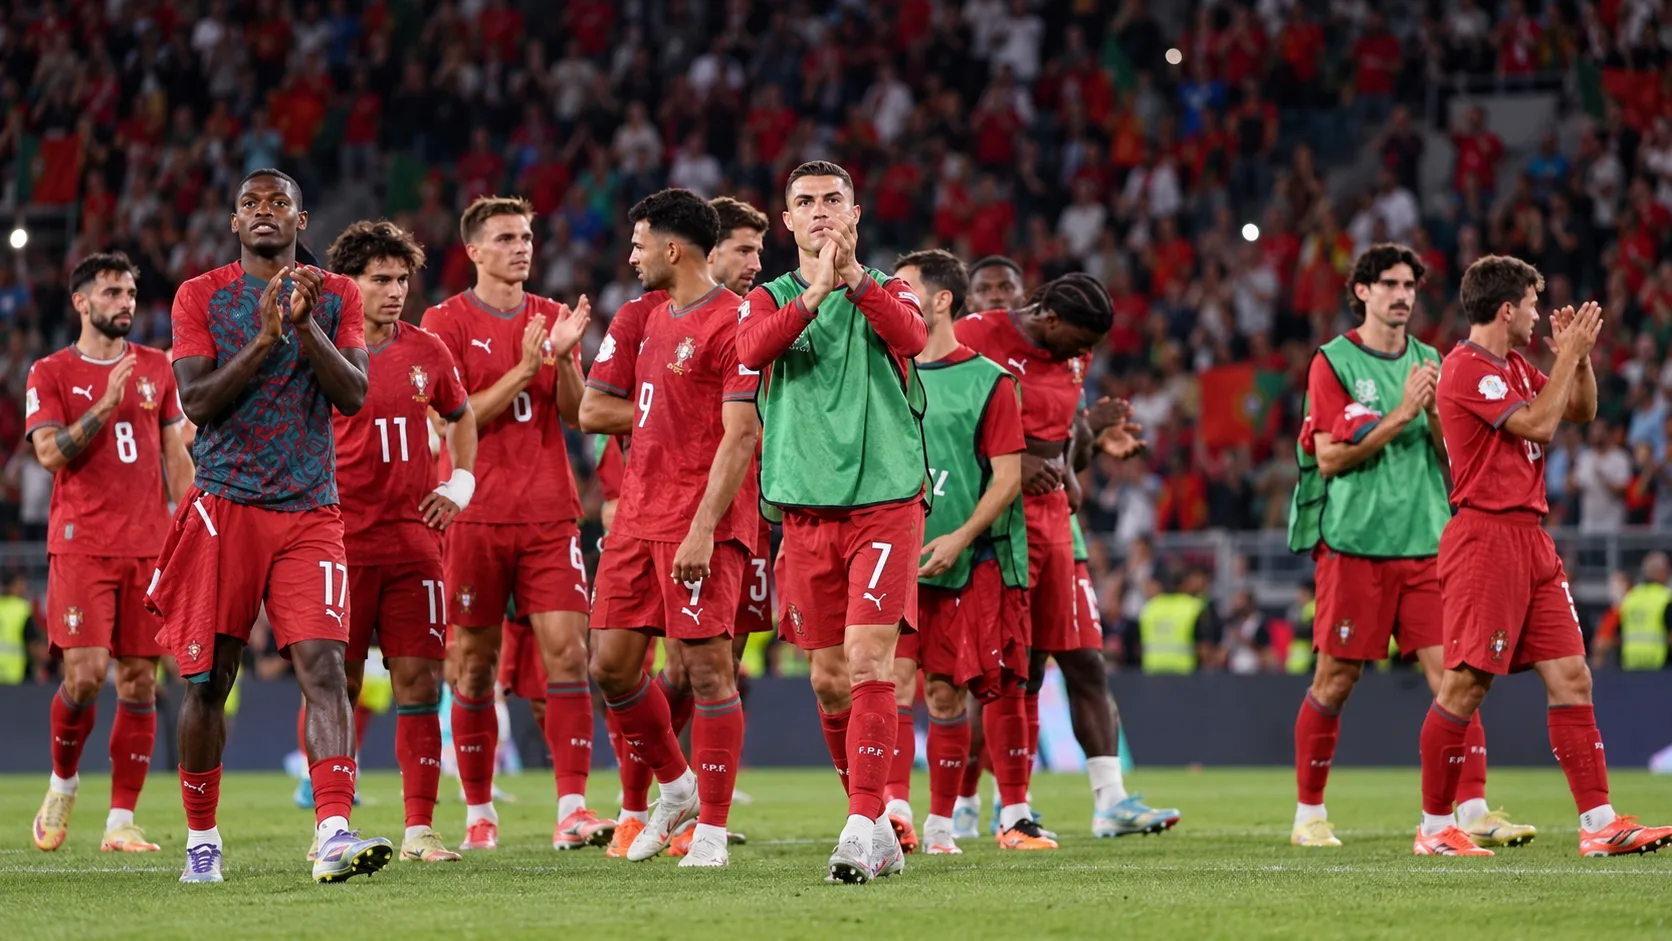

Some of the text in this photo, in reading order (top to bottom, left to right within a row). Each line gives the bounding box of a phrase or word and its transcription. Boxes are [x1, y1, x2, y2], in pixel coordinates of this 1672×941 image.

[638, 381, 653, 428] 9
[114, 421, 138, 463] 8
[374, 417, 408, 463] 11
[319, 560, 347, 609] 17
[749, 558, 767, 602] 3
[867, 542, 892, 590] 7
[421, 580, 447, 625] 11
[702, 763, 727, 773] F.P.F.
[858, 746, 884, 759] F.P.F.
